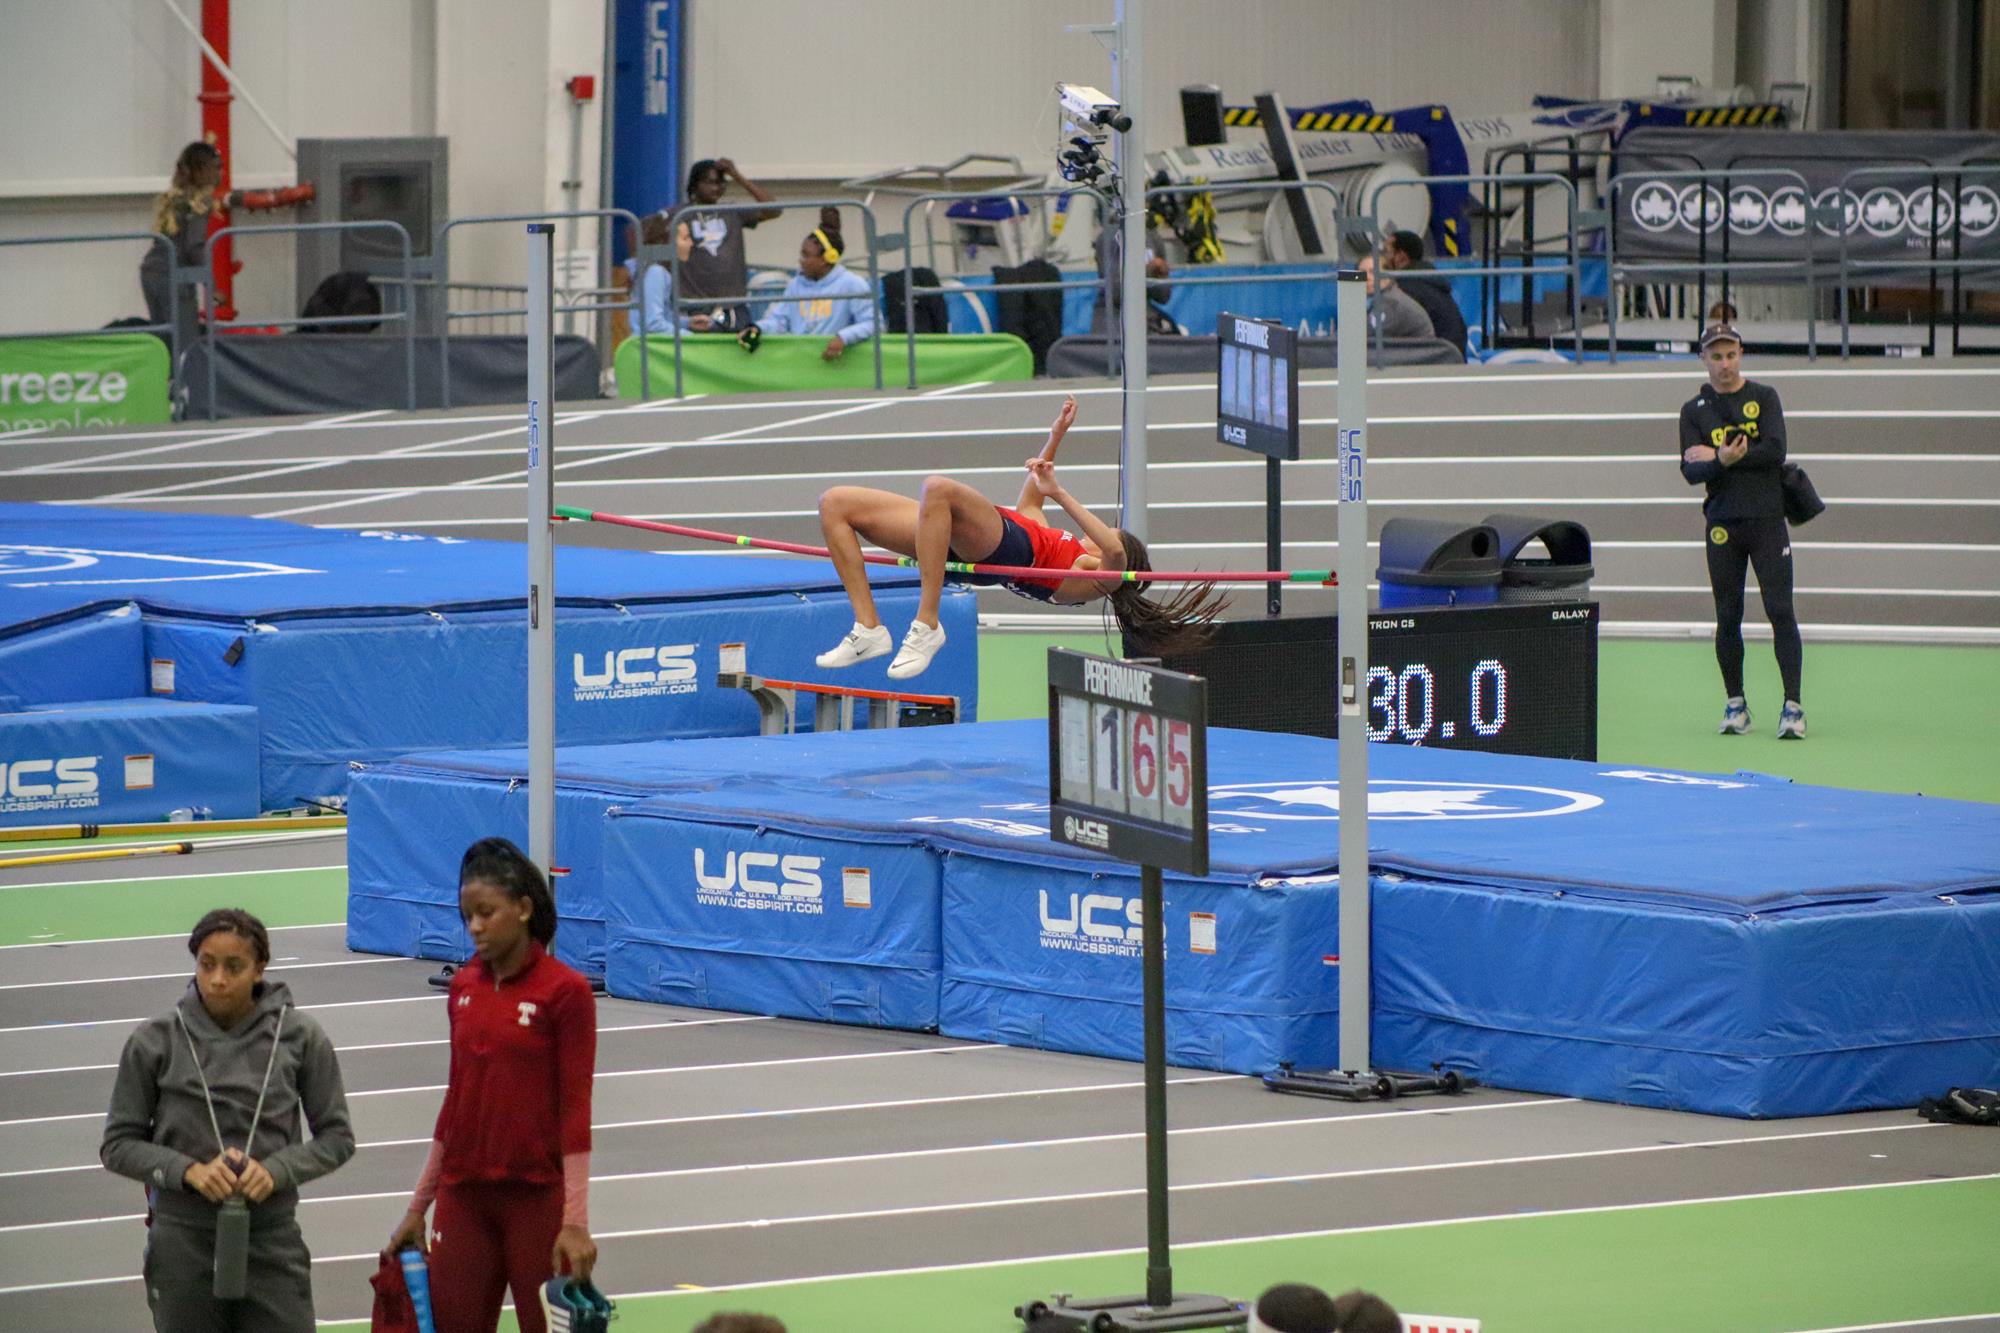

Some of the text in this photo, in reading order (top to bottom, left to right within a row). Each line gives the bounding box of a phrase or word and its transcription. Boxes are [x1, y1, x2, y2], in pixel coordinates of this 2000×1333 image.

[1, 371, 128, 403] reeze
[1349, 430, 1361, 501] UCS
[1552, 609, 1590, 620] GALAXY
[574, 643, 697, 687] UCS
[574, 684, 697, 701] WWW.UCSSPIRIT.COM
[1084, 658, 1152, 706] PERFORMANCE
[0, 756, 98, 797] CS
[1075, 817, 1109, 840] UCS
[694, 847, 823, 898] UCS
[696, 894, 823, 914] WWW.UCSSPIRIT.COM
[1040, 936, 1167, 960] WWW.UCSSPIRIT.
[517, 1002, 537, 1026] T
